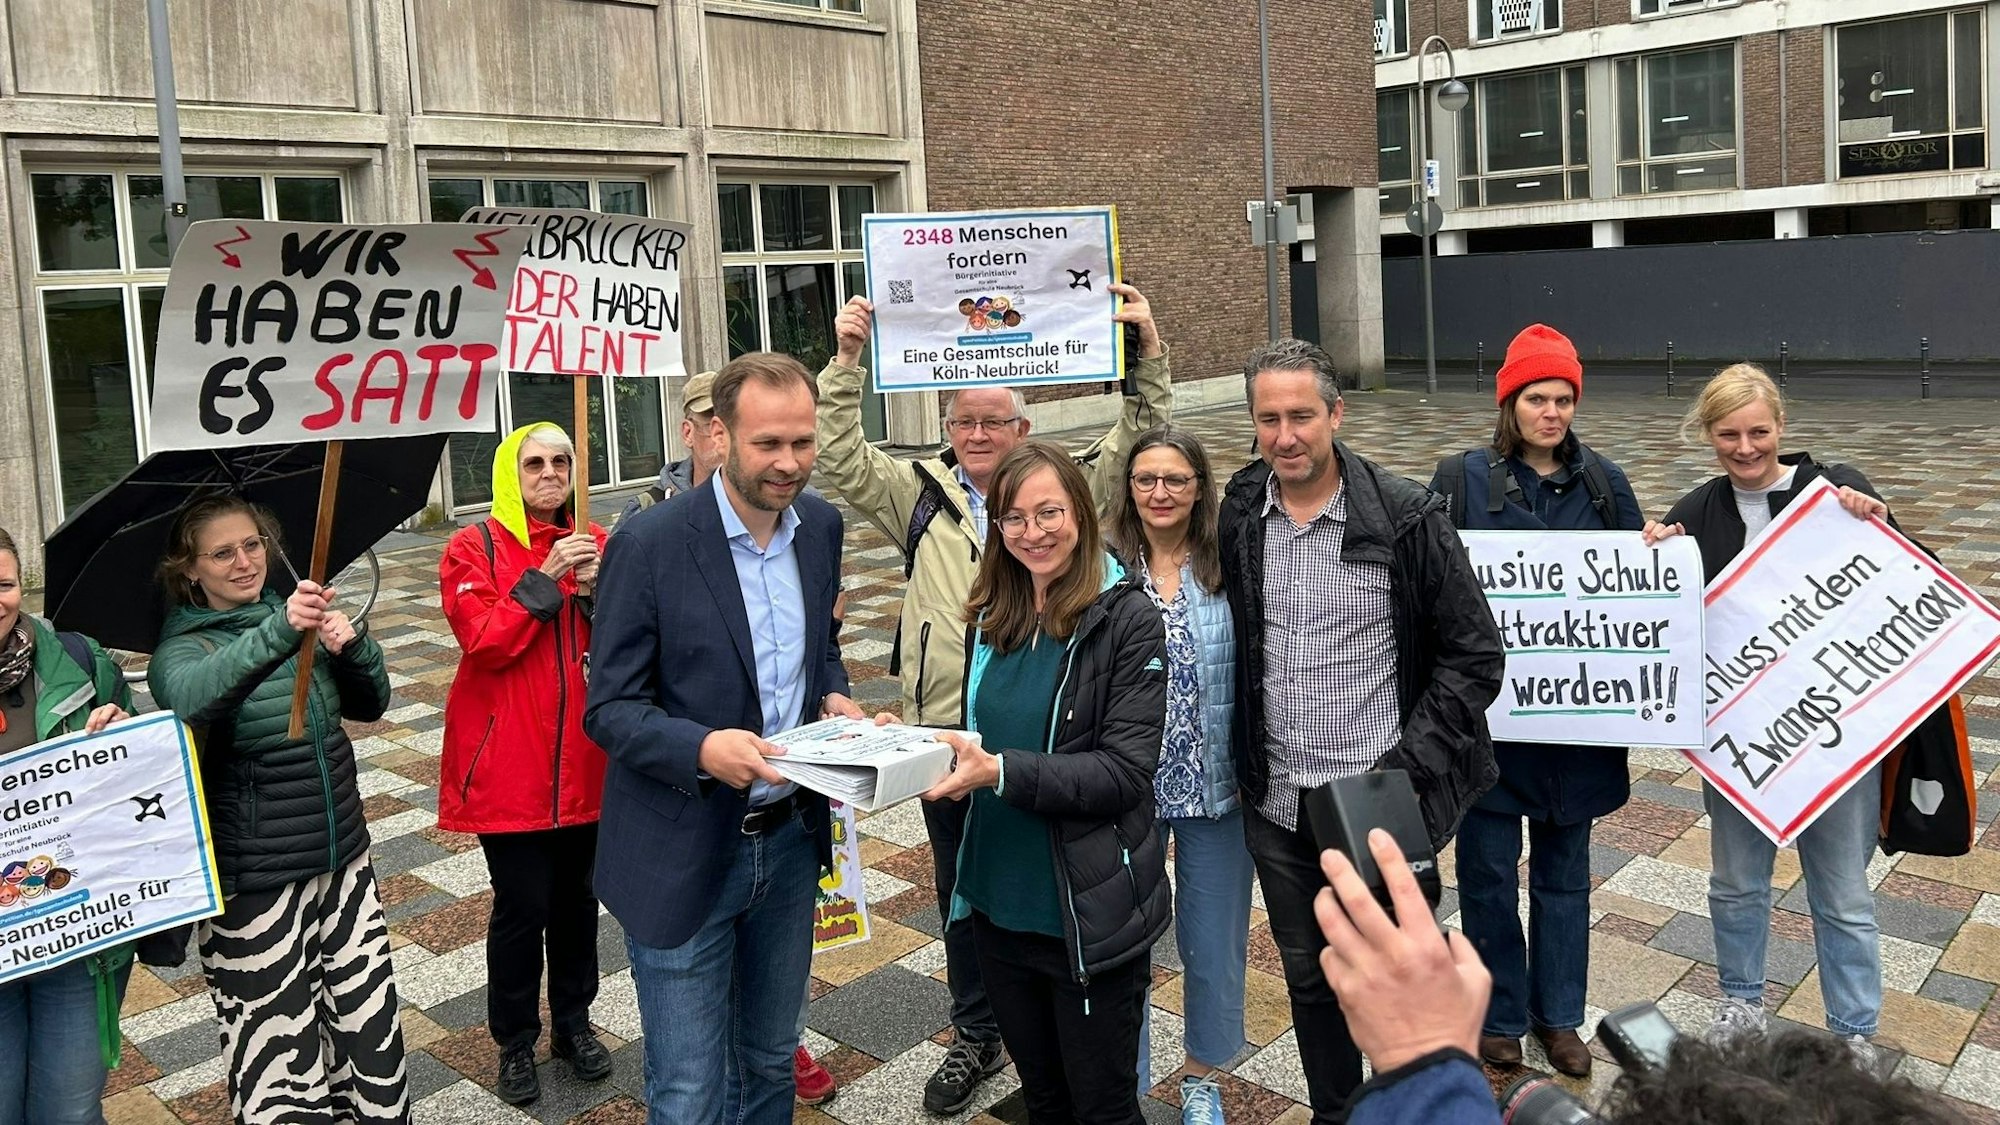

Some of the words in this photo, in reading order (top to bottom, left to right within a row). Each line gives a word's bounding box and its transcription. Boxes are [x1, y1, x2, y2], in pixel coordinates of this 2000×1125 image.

[1848, 141, 1938, 160] SENATOR
[177, 204, 184, 214] 5
[281, 228, 407, 279] WIR
[465, 210, 686, 271] BRÜCKER
[903, 228, 954, 245] 2348
[959, 222, 1068, 243] Menschen
[946, 250, 1027, 270] fordern
[955, 270, 1017, 280] Bürgerinitiative
[195, 279, 463, 347] HABEN
[507, 267, 579, 318] DER
[593, 277, 679, 332] HABEN
[505, 315, 660, 376] TALENT
[903, 349, 938, 364] Eine
[943, 342, 1059, 362] Gesamtschule
[1065, 340, 1089, 355] für
[199, 356, 287, 435] ES
[301, 343, 498, 432] SATT
[932, 360, 1059, 381] Köln-Neubrück!
[1577, 549, 1681, 594] Schule
[1498, 609, 1669, 649] ttraktiver
[1706, 636, 1777, 718] hluss
[1768, 594, 1824, 646] mit
[1804, 554, 1882, 610] dem
[1, 743, 128, 792] enschen
[0, 789, 73, 823] dern
[31, 832, 72, 849] Neubrück
[138, 879, 171, 900] für
[0, 909, 135, 970] -Neubrück!
